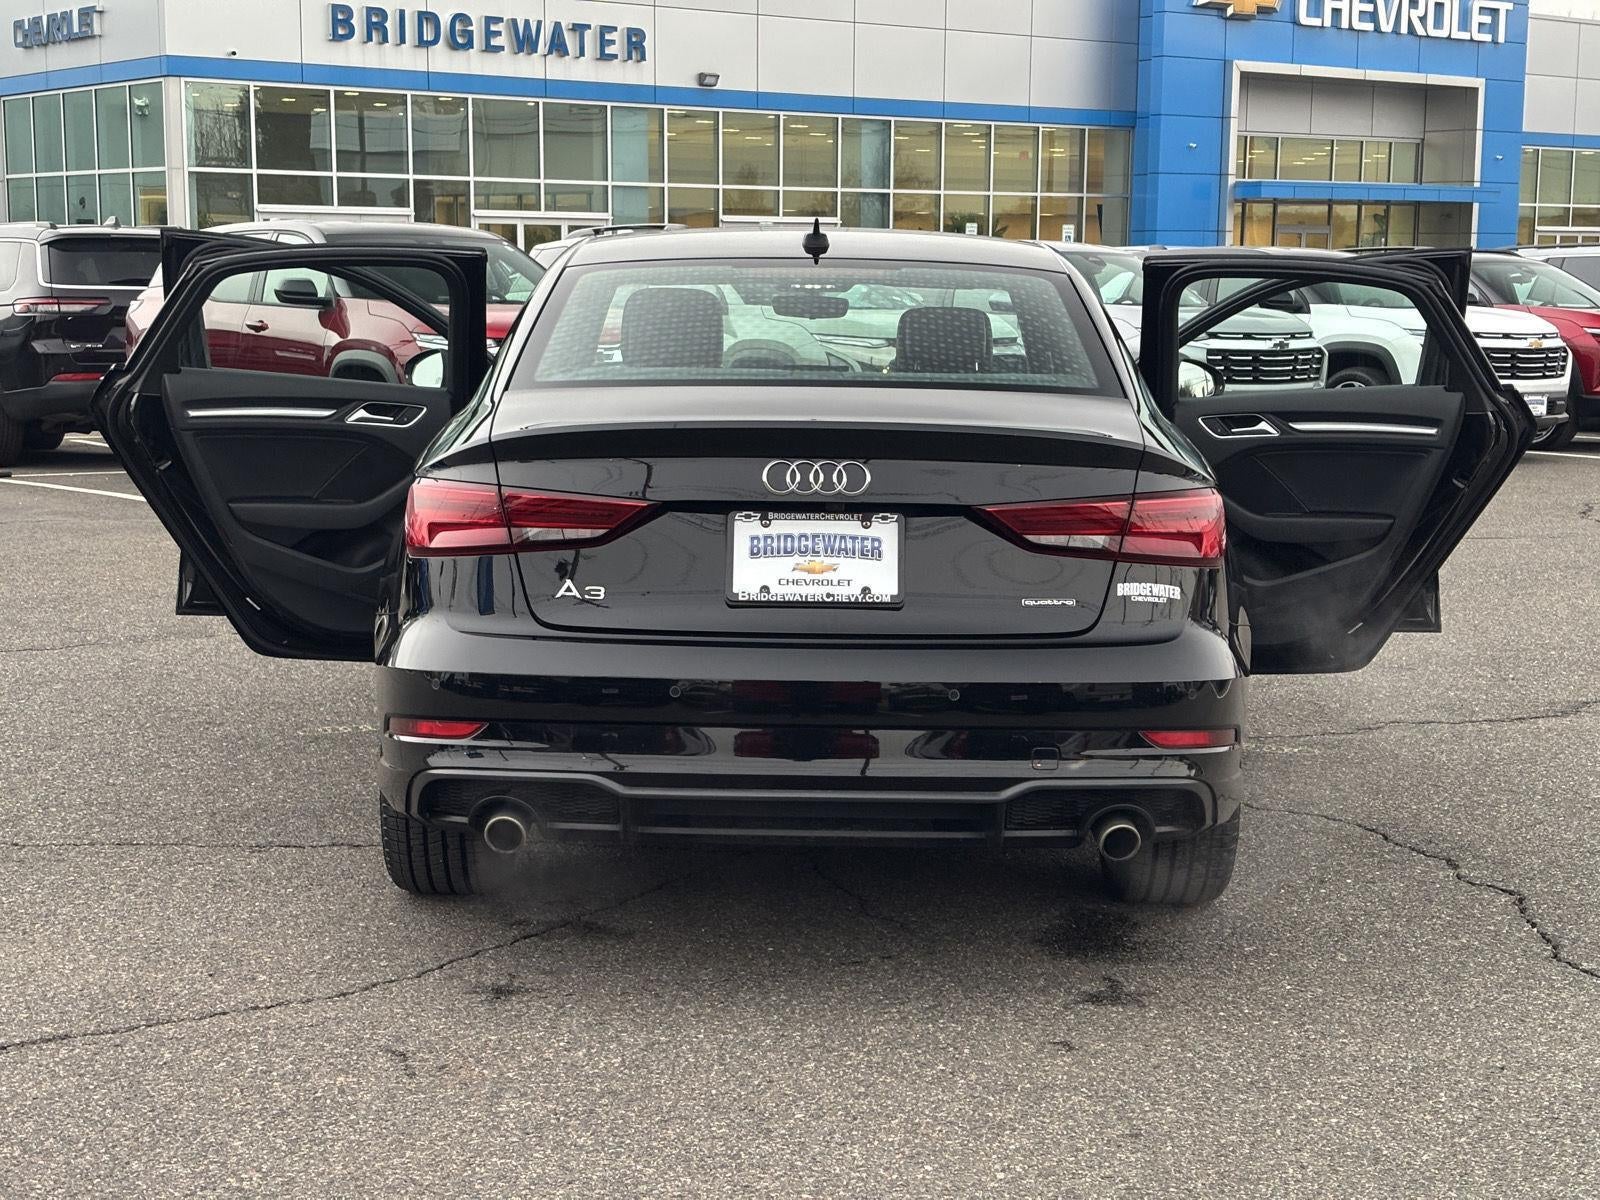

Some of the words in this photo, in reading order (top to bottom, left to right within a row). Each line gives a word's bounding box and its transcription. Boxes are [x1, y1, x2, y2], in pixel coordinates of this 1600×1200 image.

[13, 5, 97, 47] CHEVROLET
[329, 3, 647, 62] BRIDGEWATER
[1298, 0, 1514, 43] CHEVROLET
[749, 533, 882, 560] BRIDGEWATER
[778, 578, 852, 586] CHEVROLET
[1117, 582, 1181, 600] BRIDGEWATER
